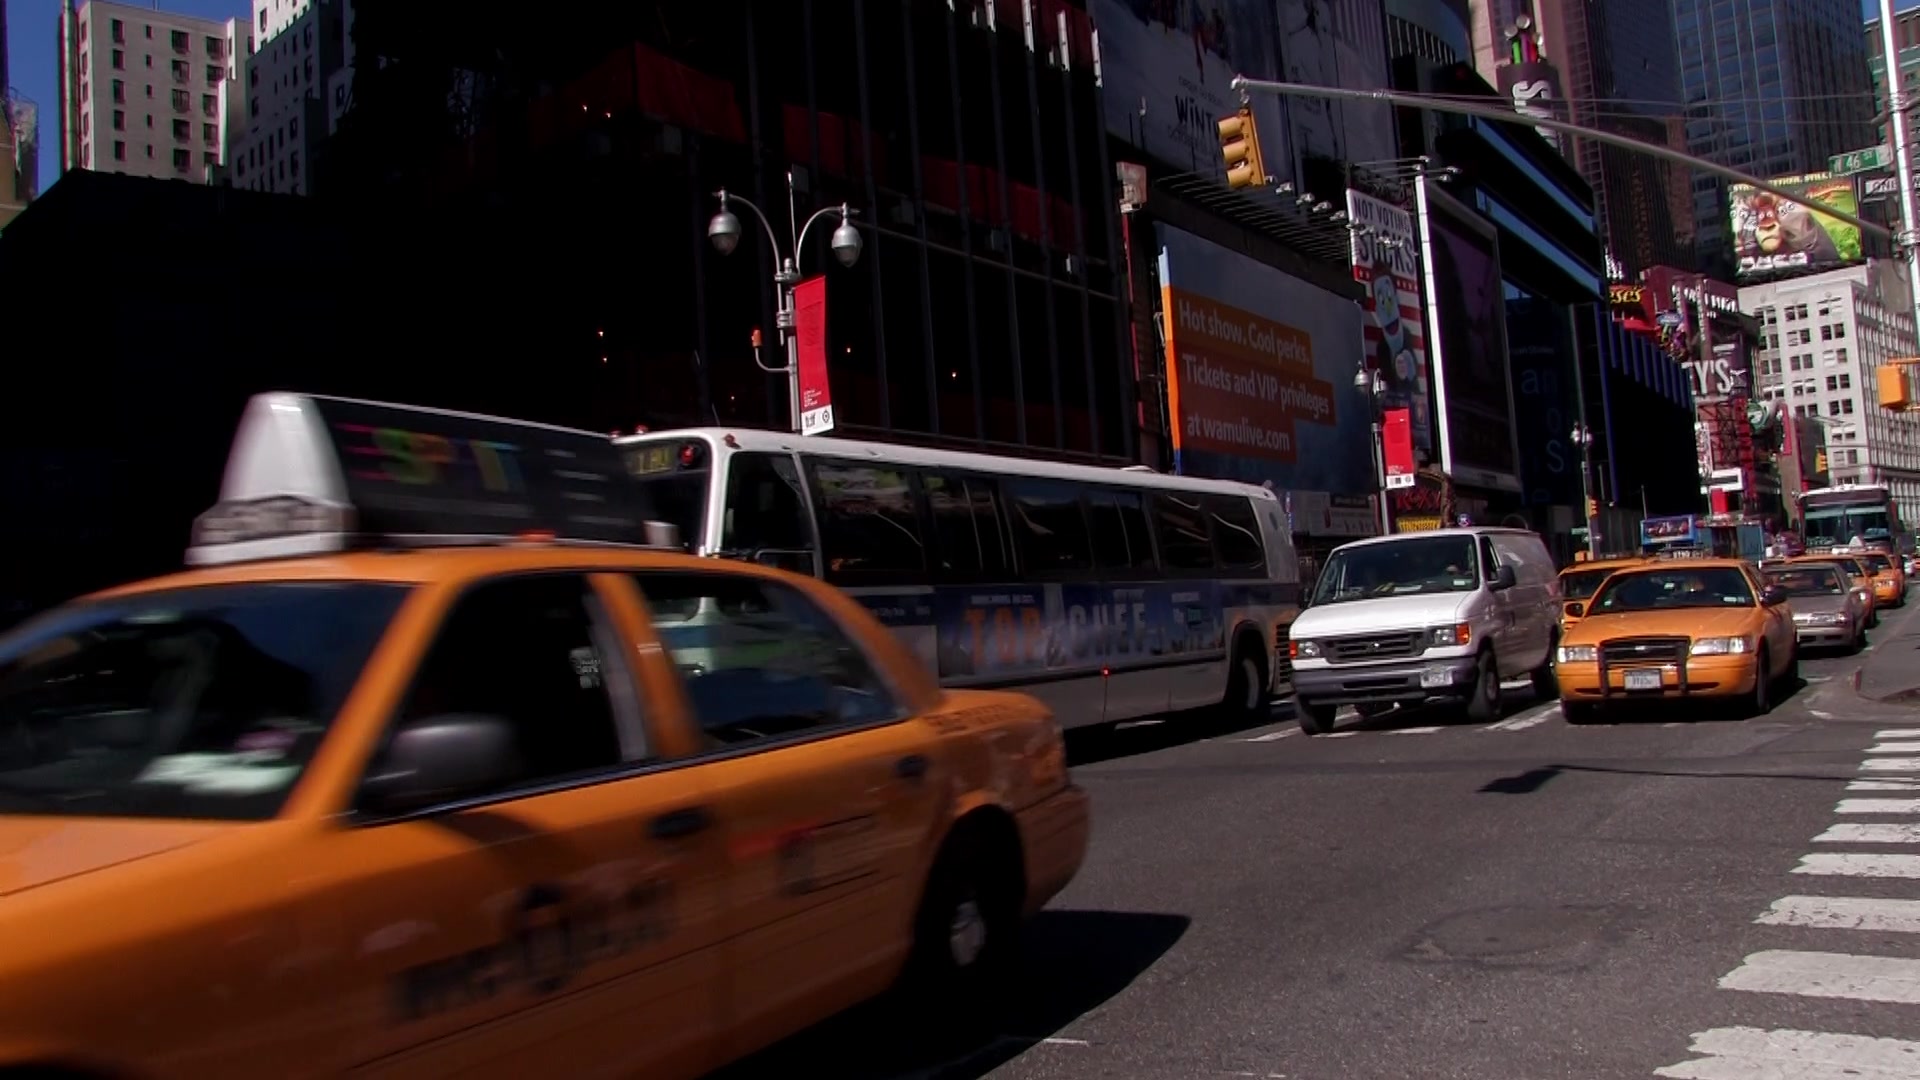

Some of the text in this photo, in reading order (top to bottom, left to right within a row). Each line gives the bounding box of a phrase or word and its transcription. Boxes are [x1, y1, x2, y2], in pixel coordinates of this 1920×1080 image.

[1846, 153, 1861, 169] 46
[1353, 196, 1411, 233] NOT VOTING
[1358, 229, 1416, 275] SUCKS
[1179, 300, 1311, 365] Hot show. Cool perks.
[1182, 353, 1330, 419] Tickets and VIP privileges
[1187, 414, 1291, 451] at wamulive.com
